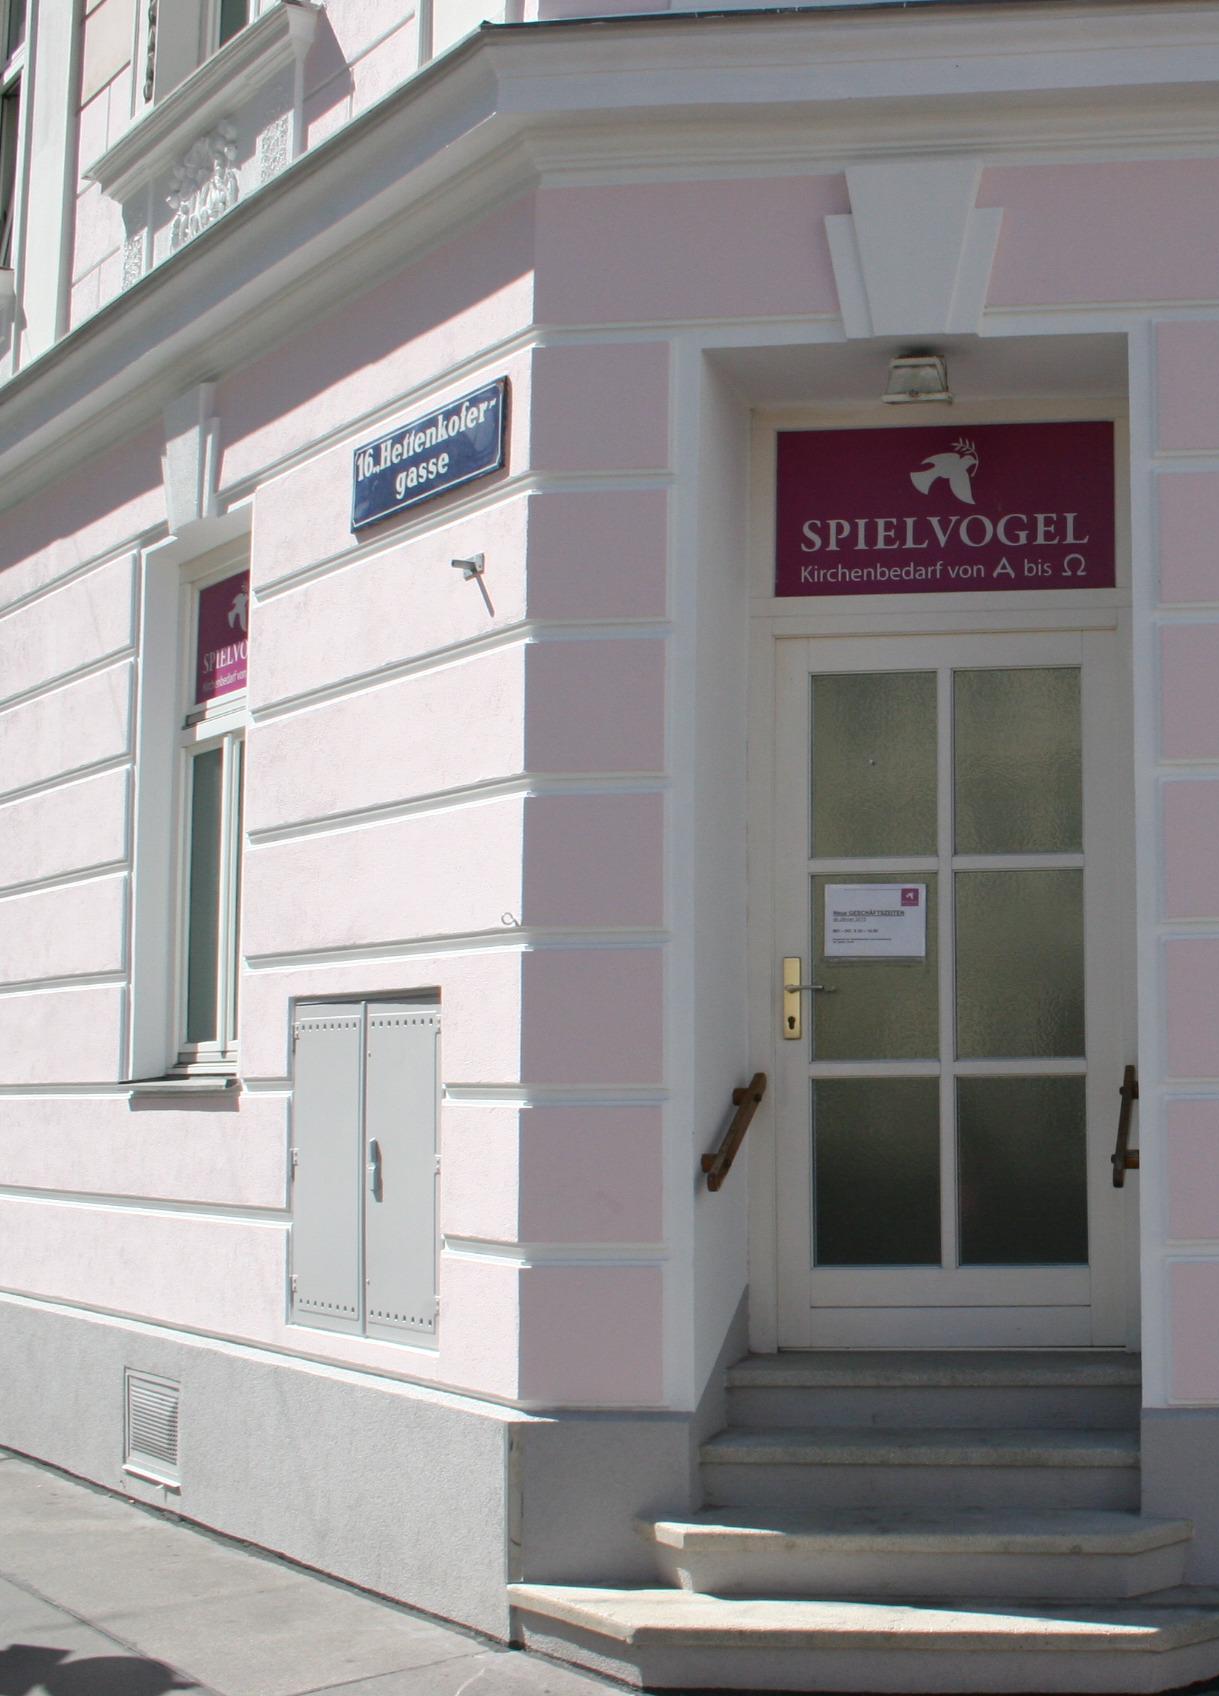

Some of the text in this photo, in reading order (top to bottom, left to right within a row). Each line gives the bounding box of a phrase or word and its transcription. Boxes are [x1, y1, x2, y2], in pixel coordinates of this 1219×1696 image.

[395, 452, 450, 500] gasse
[800, 512, 1089, 552] SPIELVOGEL
[800, 560, 943, 583] Kirchenbedarf
[949, 563, 985, 578] von
[992, 556, 1016, 579] A
[1023, 558, 1052, 577] bis
